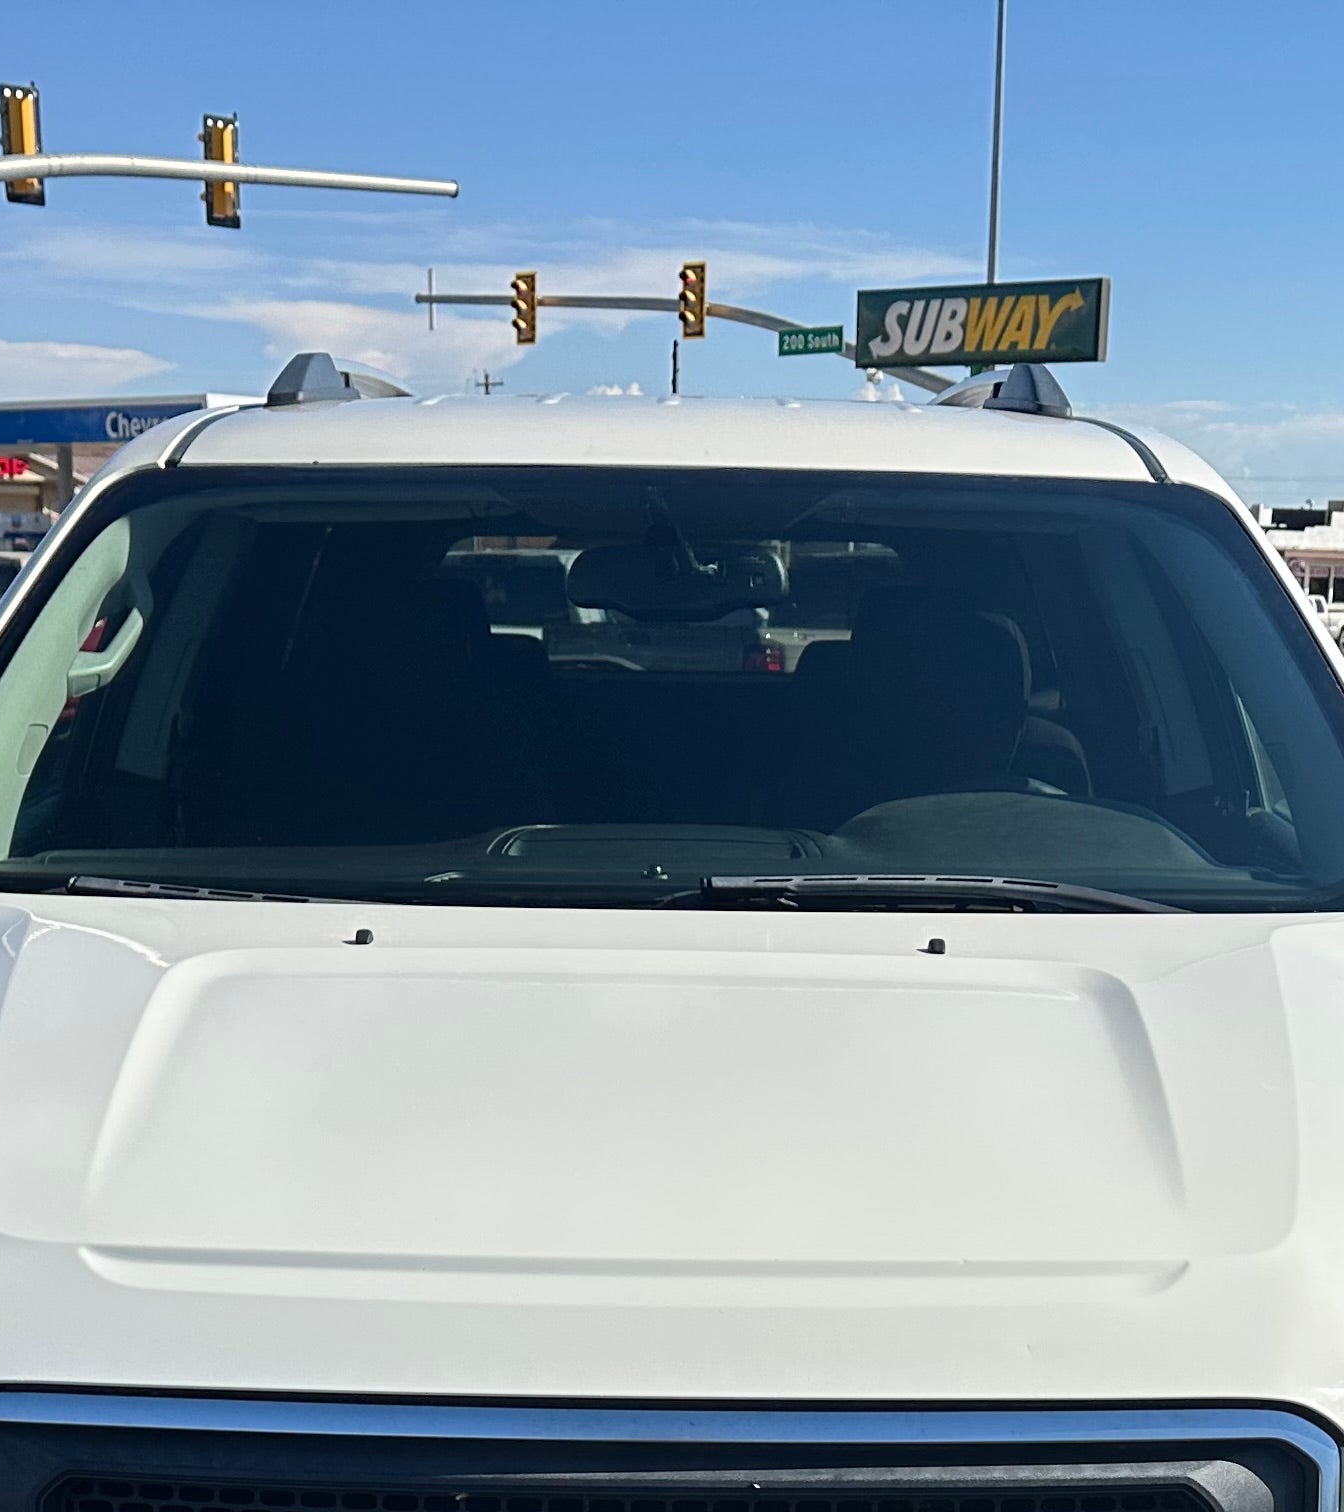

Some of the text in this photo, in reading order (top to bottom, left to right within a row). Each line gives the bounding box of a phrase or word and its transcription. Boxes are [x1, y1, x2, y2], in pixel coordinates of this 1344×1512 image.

[868, 286, 1085, 360] SUBWAY
[782, 332, 840, 350] 200 South
[105, 412, 169, 439] Chev
